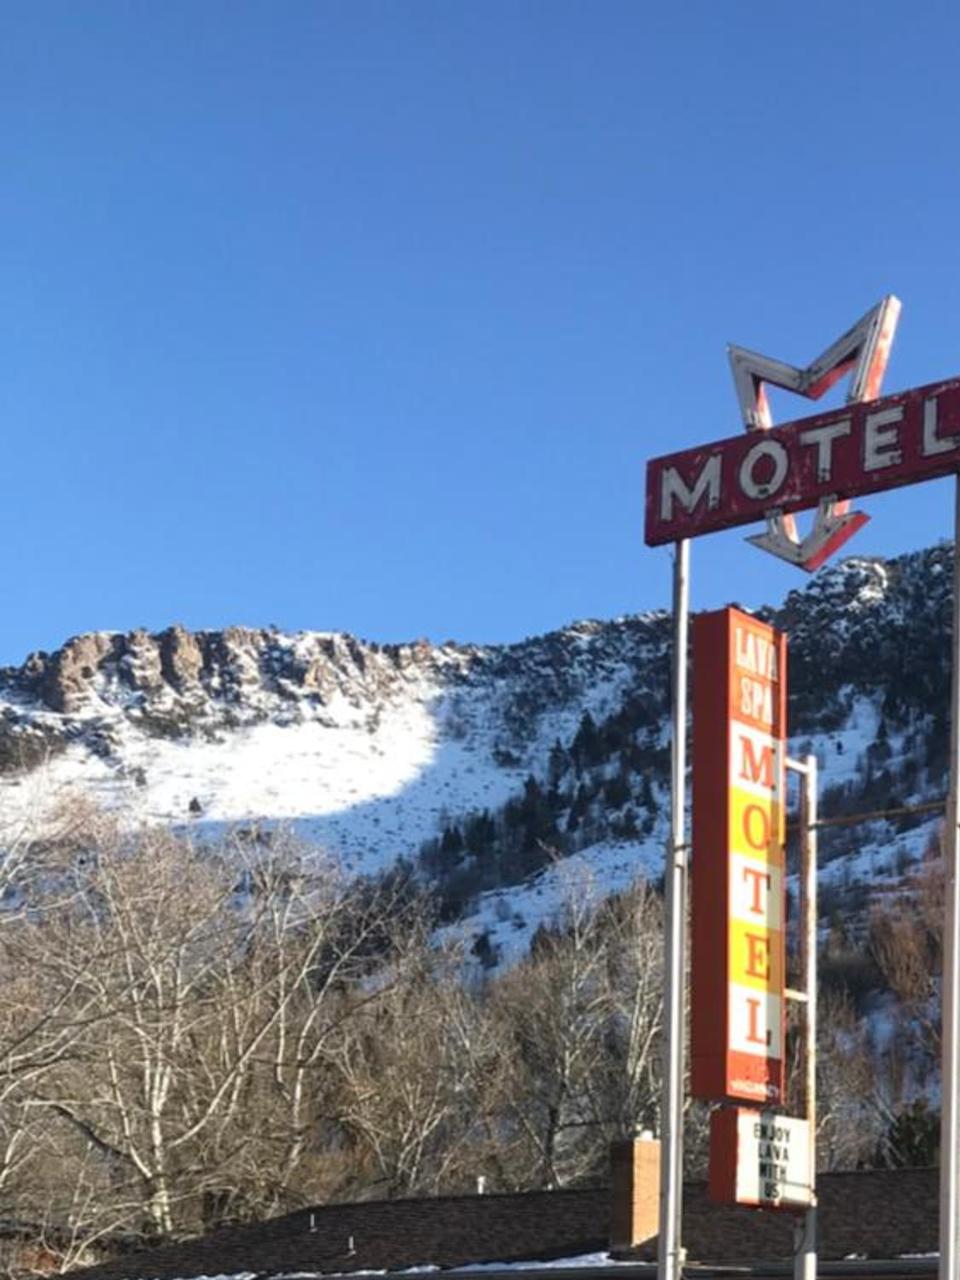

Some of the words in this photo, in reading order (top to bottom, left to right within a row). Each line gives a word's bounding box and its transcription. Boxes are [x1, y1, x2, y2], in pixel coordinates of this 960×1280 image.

[735, 627, 778, 682] LAVA
[739, 675, 774, 725] SPA
[738, 735, 776, 1046] MOTEL
[753, 1122, 791, 1142] ENJOY
